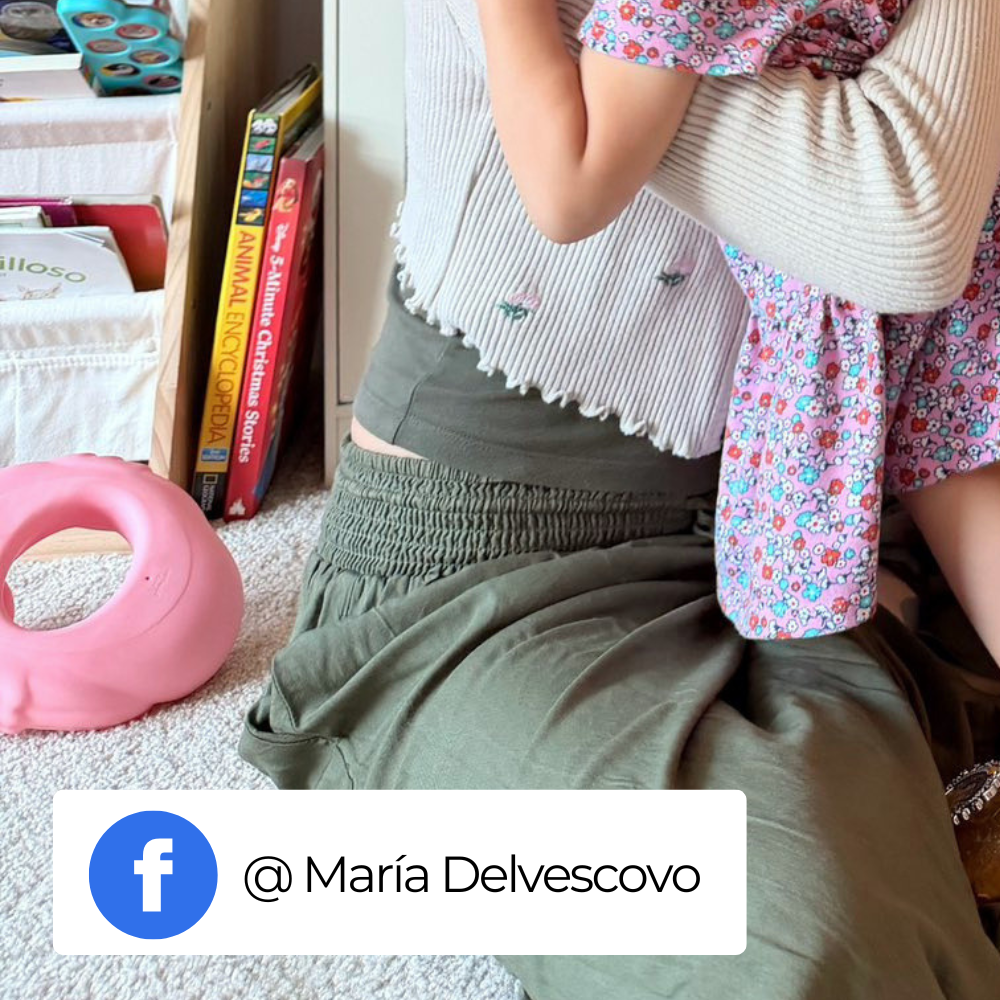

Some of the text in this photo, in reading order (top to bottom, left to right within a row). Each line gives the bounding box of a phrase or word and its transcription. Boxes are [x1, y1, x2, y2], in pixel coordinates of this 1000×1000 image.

[260, 254, 284, 327] 5-Minute
[208, 230, 256, 444] ANIMAL ENCYCLOPEDIA
[248, 329, 272, 407] Christmas
[238, 409, 259, 464] Stories
